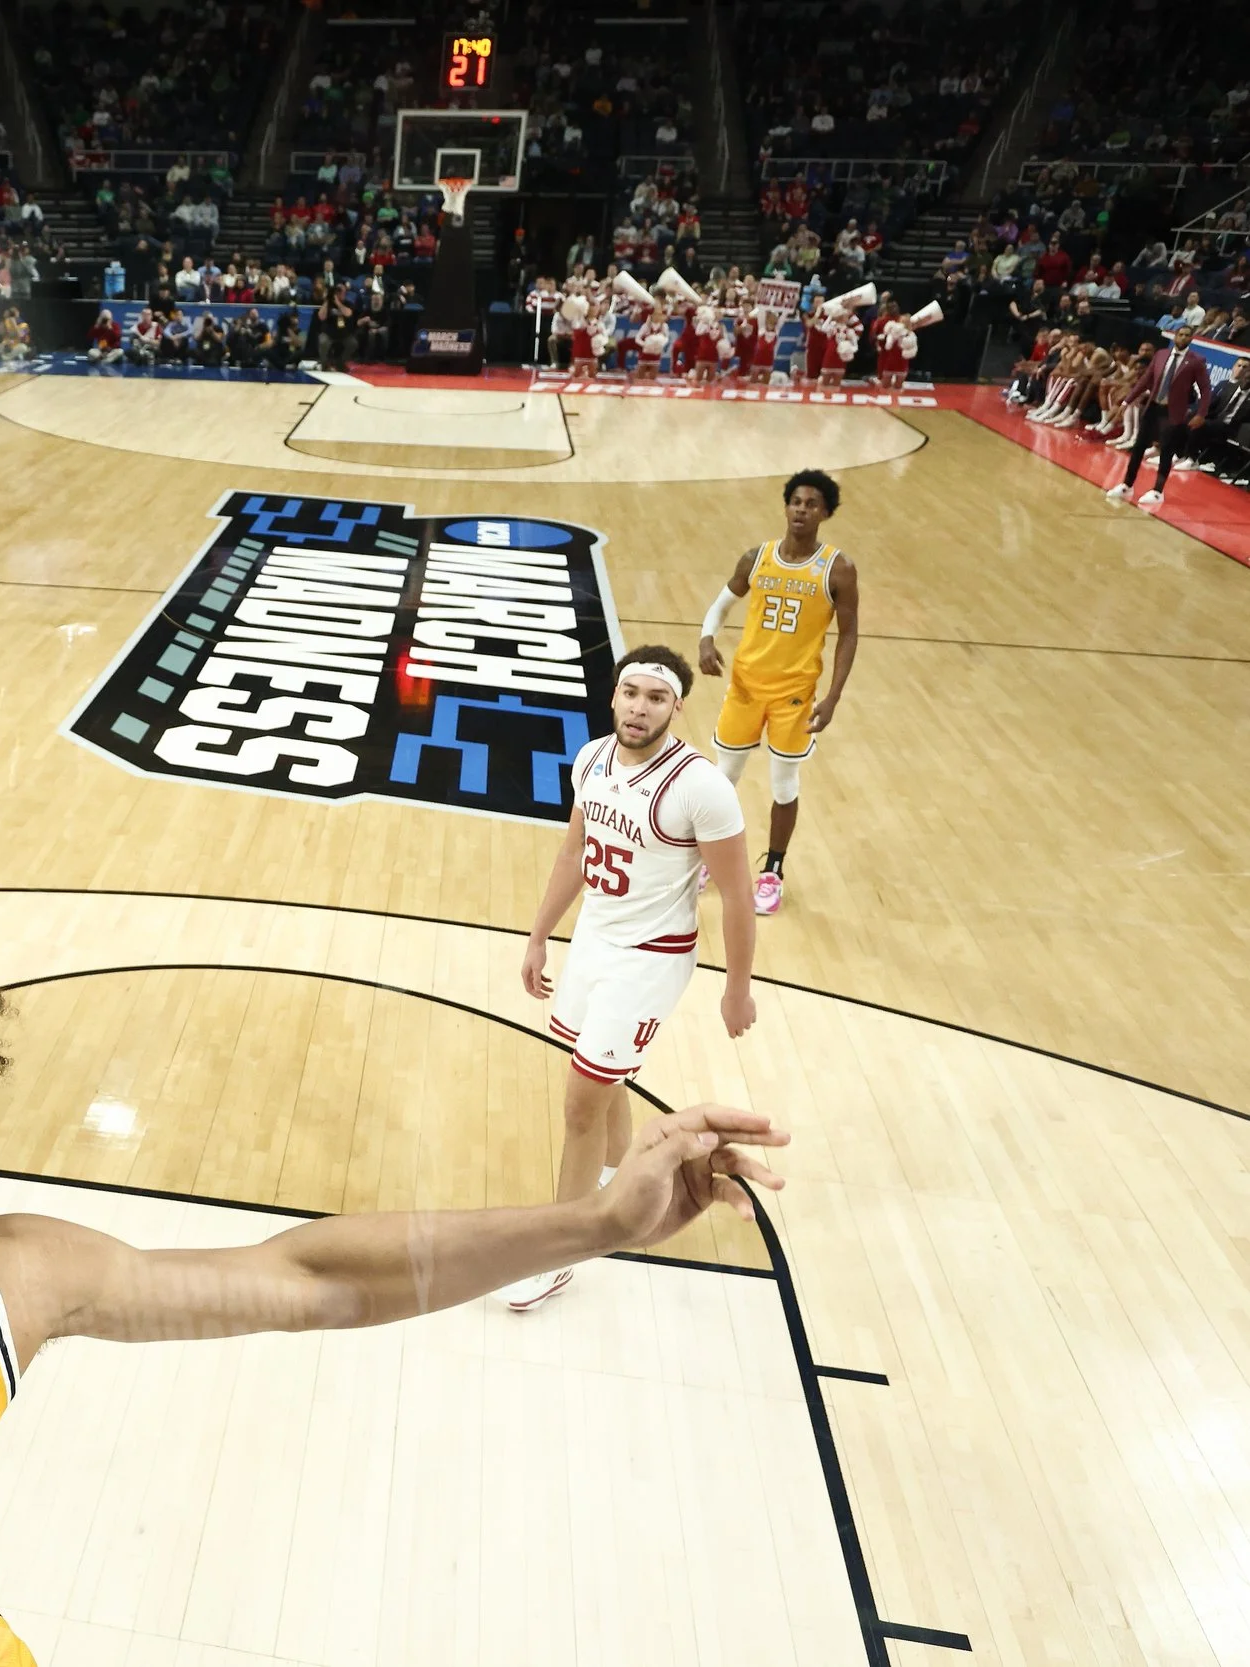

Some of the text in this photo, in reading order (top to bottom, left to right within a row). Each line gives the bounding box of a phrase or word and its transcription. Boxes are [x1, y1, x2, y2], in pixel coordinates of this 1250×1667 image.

[453, 38, 491, 57] 17:40
[449, 55, 486, 87] 21
[529, 381, 938, 407] FIRST ROUND
[785, 578, 818, 597] STATE
[405, 542, 588, 698] MARCH
[762, 595, 802, 635] 33
[153, 546, 410, 787] MADNESS
[582, 800, 646, 849] NDIANA
[583, 835, 634, 898] 25
